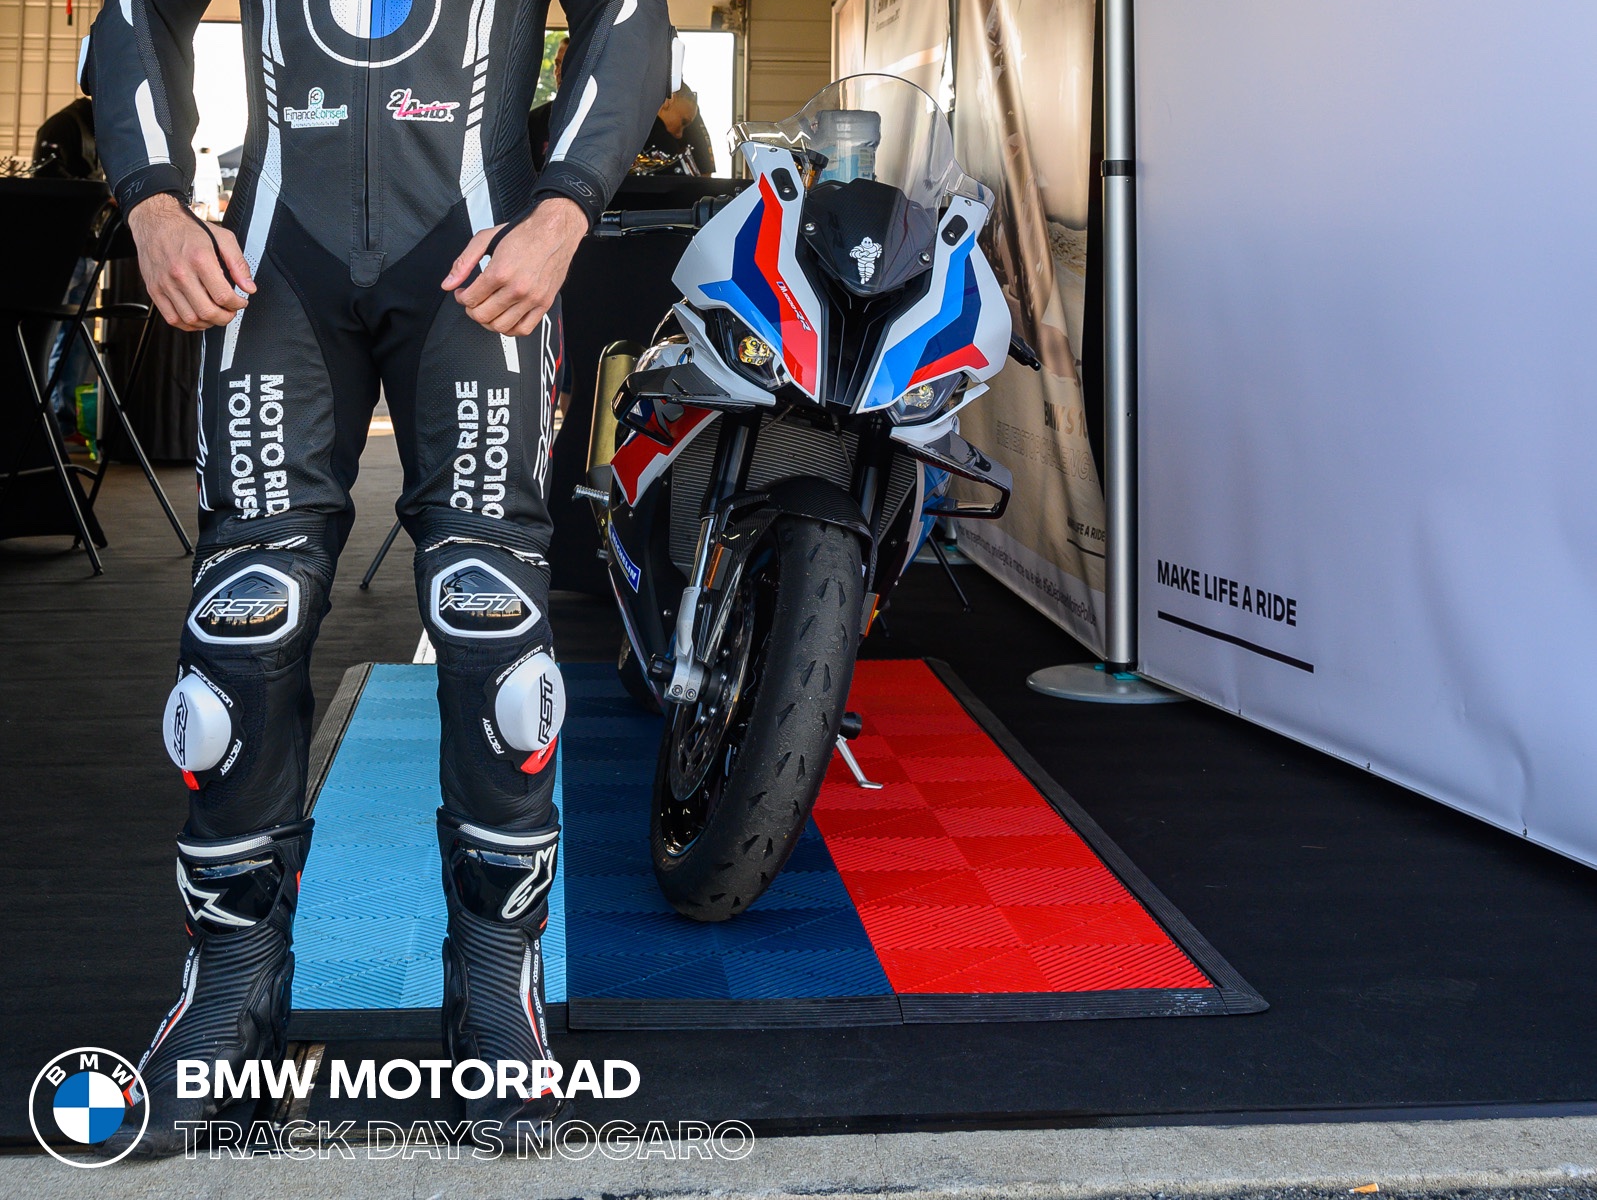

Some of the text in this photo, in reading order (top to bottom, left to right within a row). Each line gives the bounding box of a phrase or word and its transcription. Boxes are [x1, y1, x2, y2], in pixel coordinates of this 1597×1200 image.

[284, 104, 347, 121] FinanceConseil
[259, 374, 290, 517] MOTO RID
[450, 380, 479, 513] OTO RIDE
[481, 387, 510, 520] OULOUSE
[199, 598, 287, 618] RST
[440, 593, 522, 611] RST
[1157, 559, 1297, 627] MAKE LIFE A RIDE
[537, 673, 553, 745] RST
